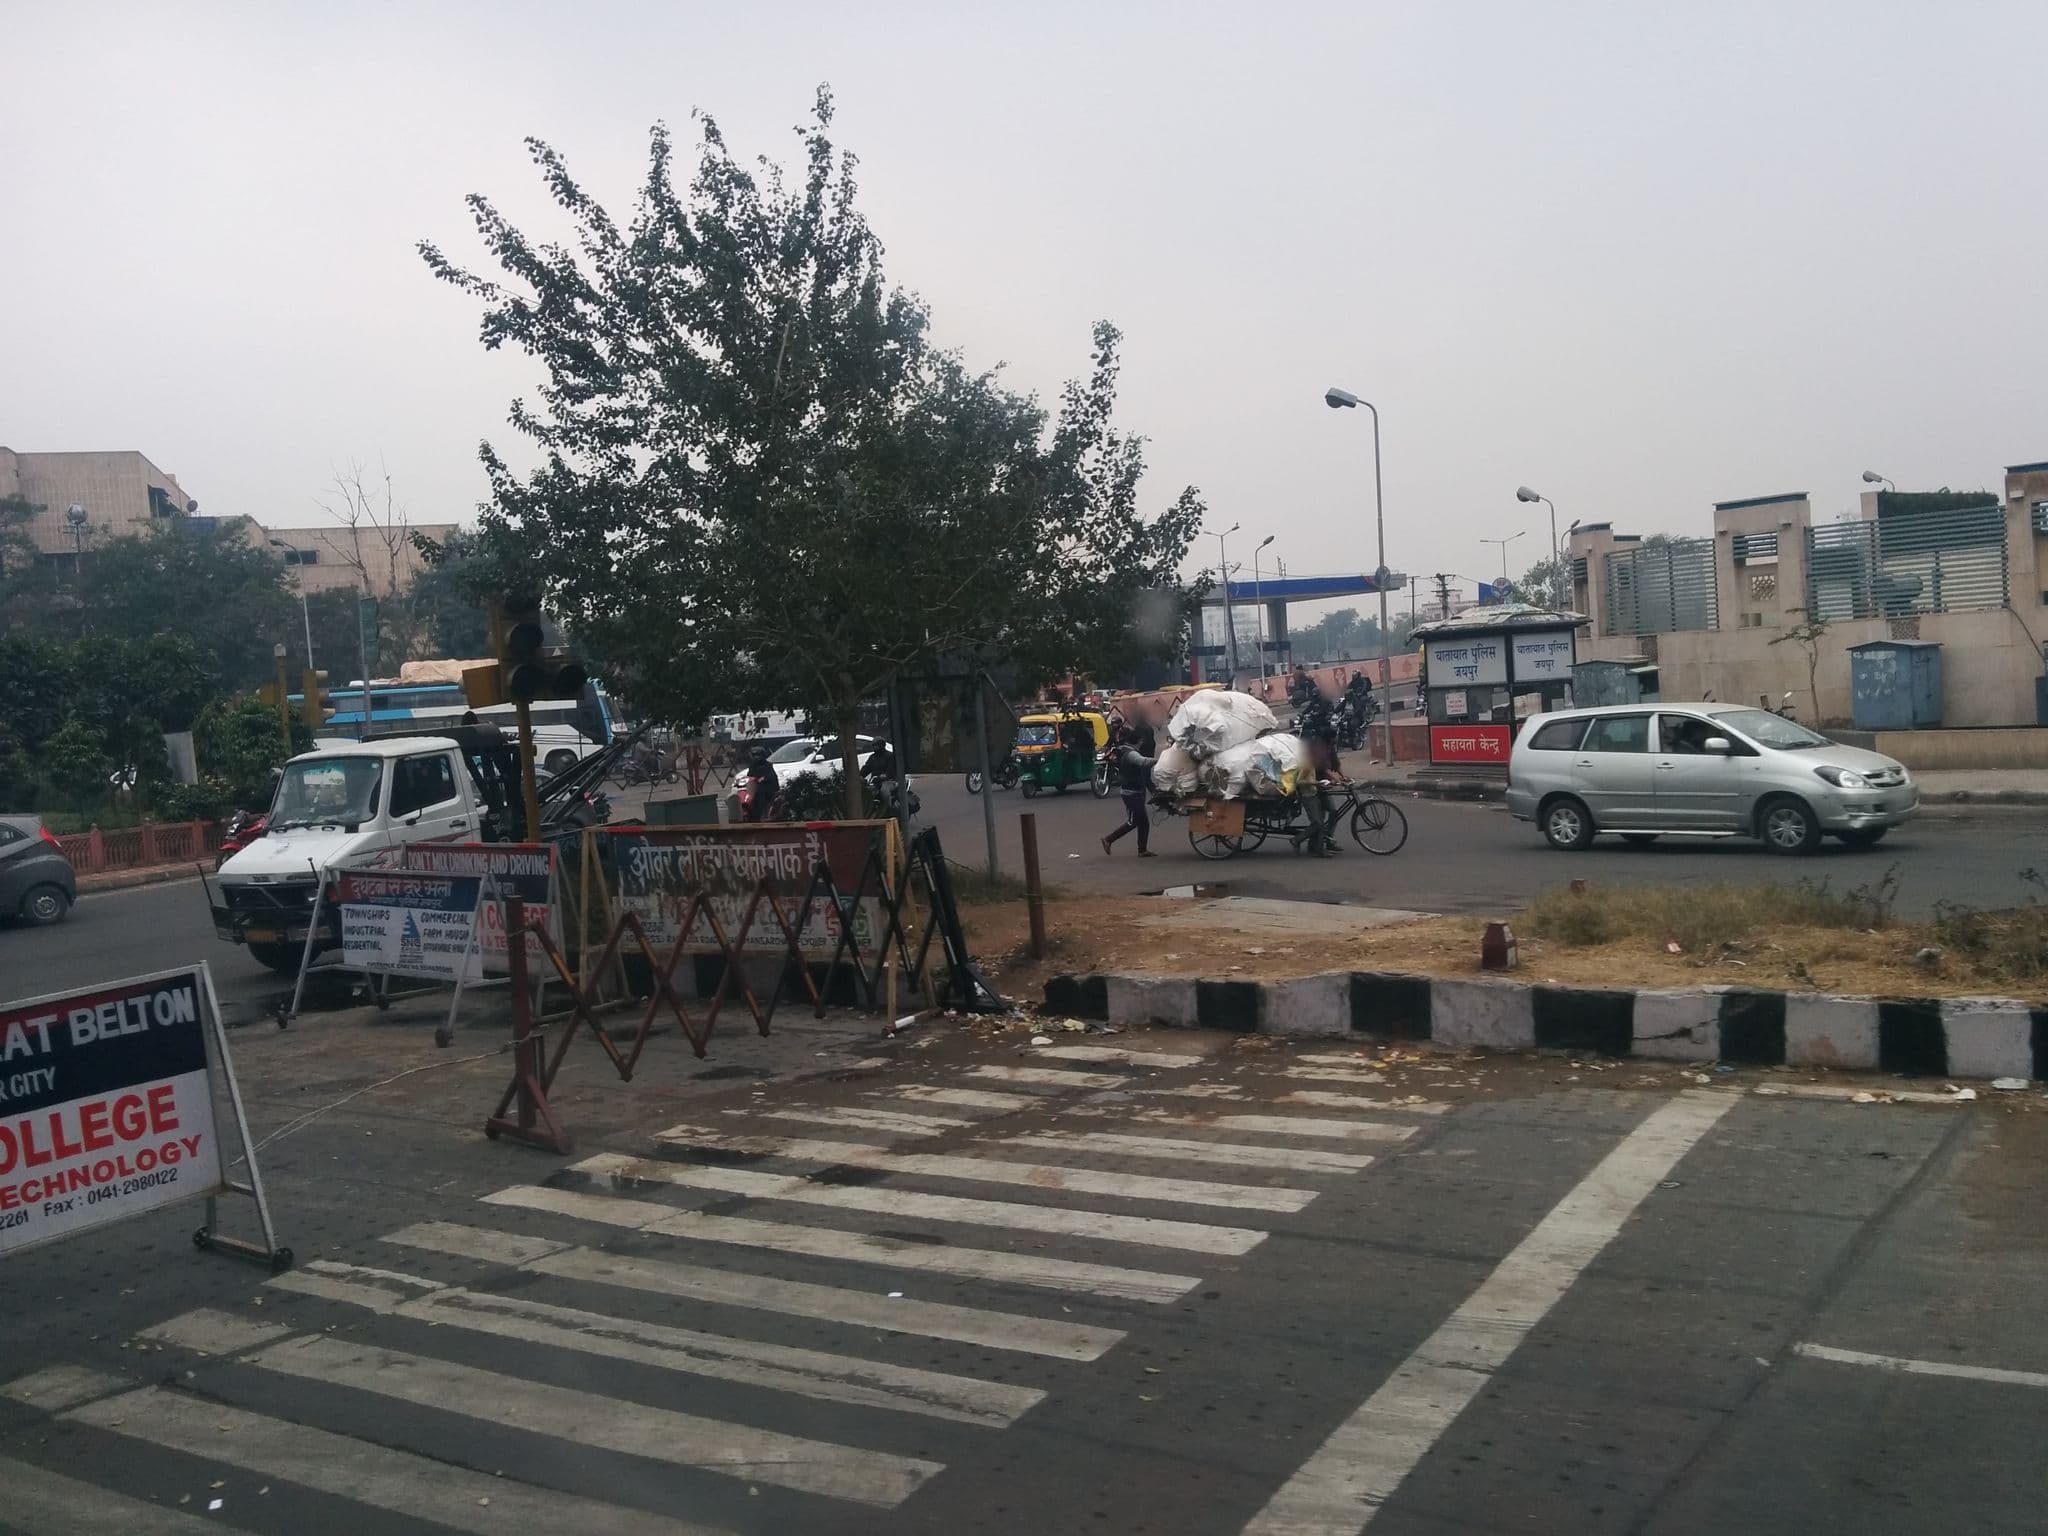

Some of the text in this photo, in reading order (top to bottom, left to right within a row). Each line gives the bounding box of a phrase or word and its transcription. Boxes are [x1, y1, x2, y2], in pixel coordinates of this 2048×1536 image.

[1471, 643, 1496, 663] पुलिस
[1453, 664, 1479, 681] जयपुर
[1441, 733, 1500, 754] सहायता केन्द्र
[489, 854, 509, 874] AND
[509, 854, 550, 875] DRIVING
[0, 1014, 57, 1062] AT
[11, 1066, 56, 1096] CITY
